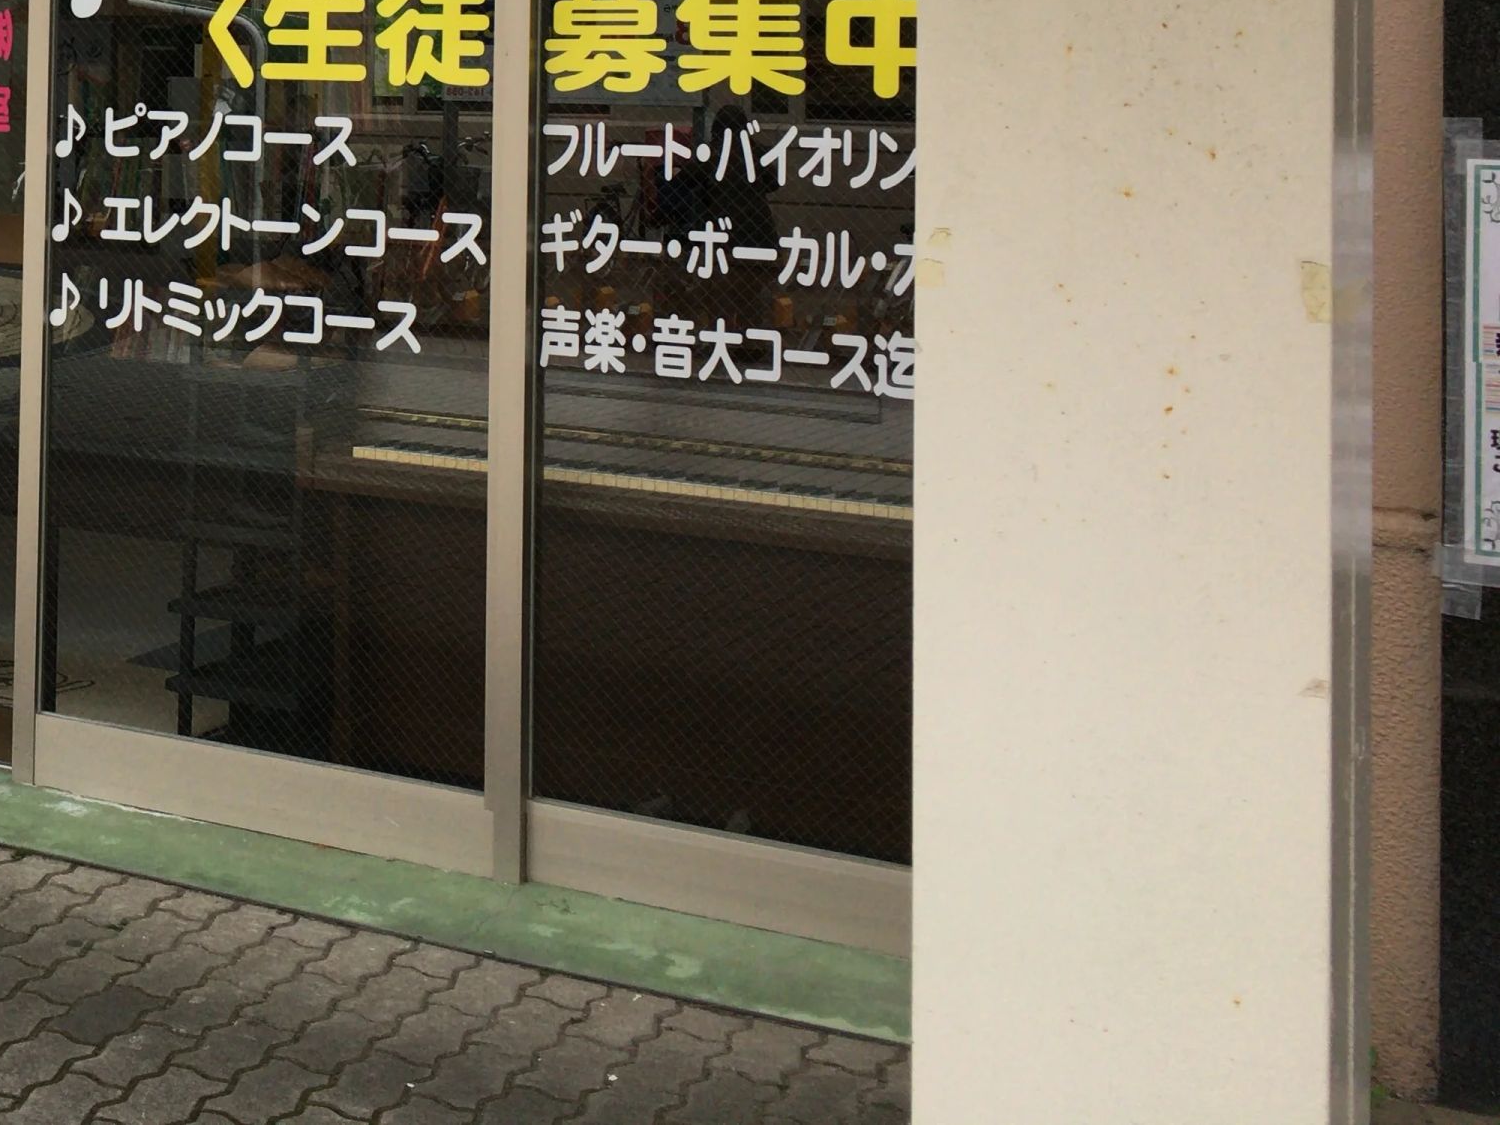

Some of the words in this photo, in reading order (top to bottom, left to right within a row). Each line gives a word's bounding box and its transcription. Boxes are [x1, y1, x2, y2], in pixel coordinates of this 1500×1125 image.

[104, 102, 357, 167] ピアノコース
[100, 195, 487, 266] エレクトーンコース
[98, 277, 421, 354] リトミックコース
